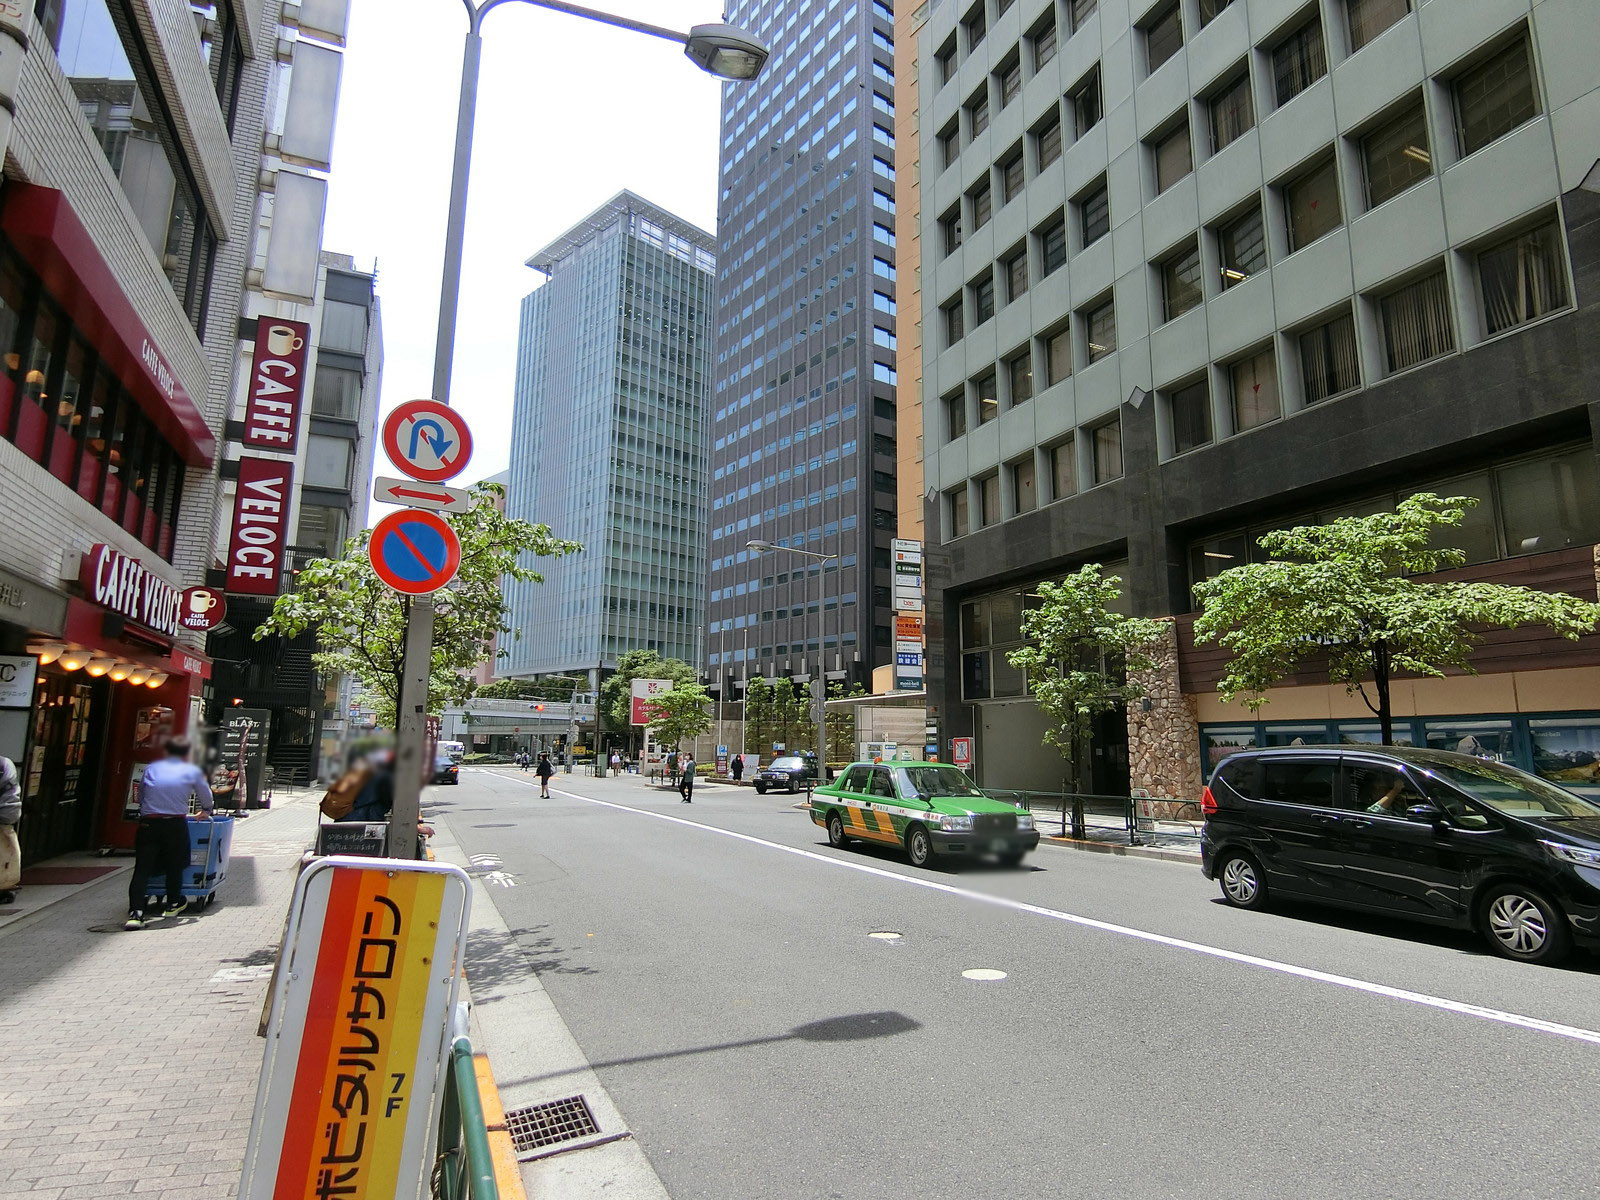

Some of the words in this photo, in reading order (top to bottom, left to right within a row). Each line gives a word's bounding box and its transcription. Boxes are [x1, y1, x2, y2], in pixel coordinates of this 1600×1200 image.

[233, 476, 284, 580] VELOCE
[143, 571, 184, 637] VELOCE
[184, 617, 210, 627] VELOCE
[385, 1073, 406, 1118] 7F
